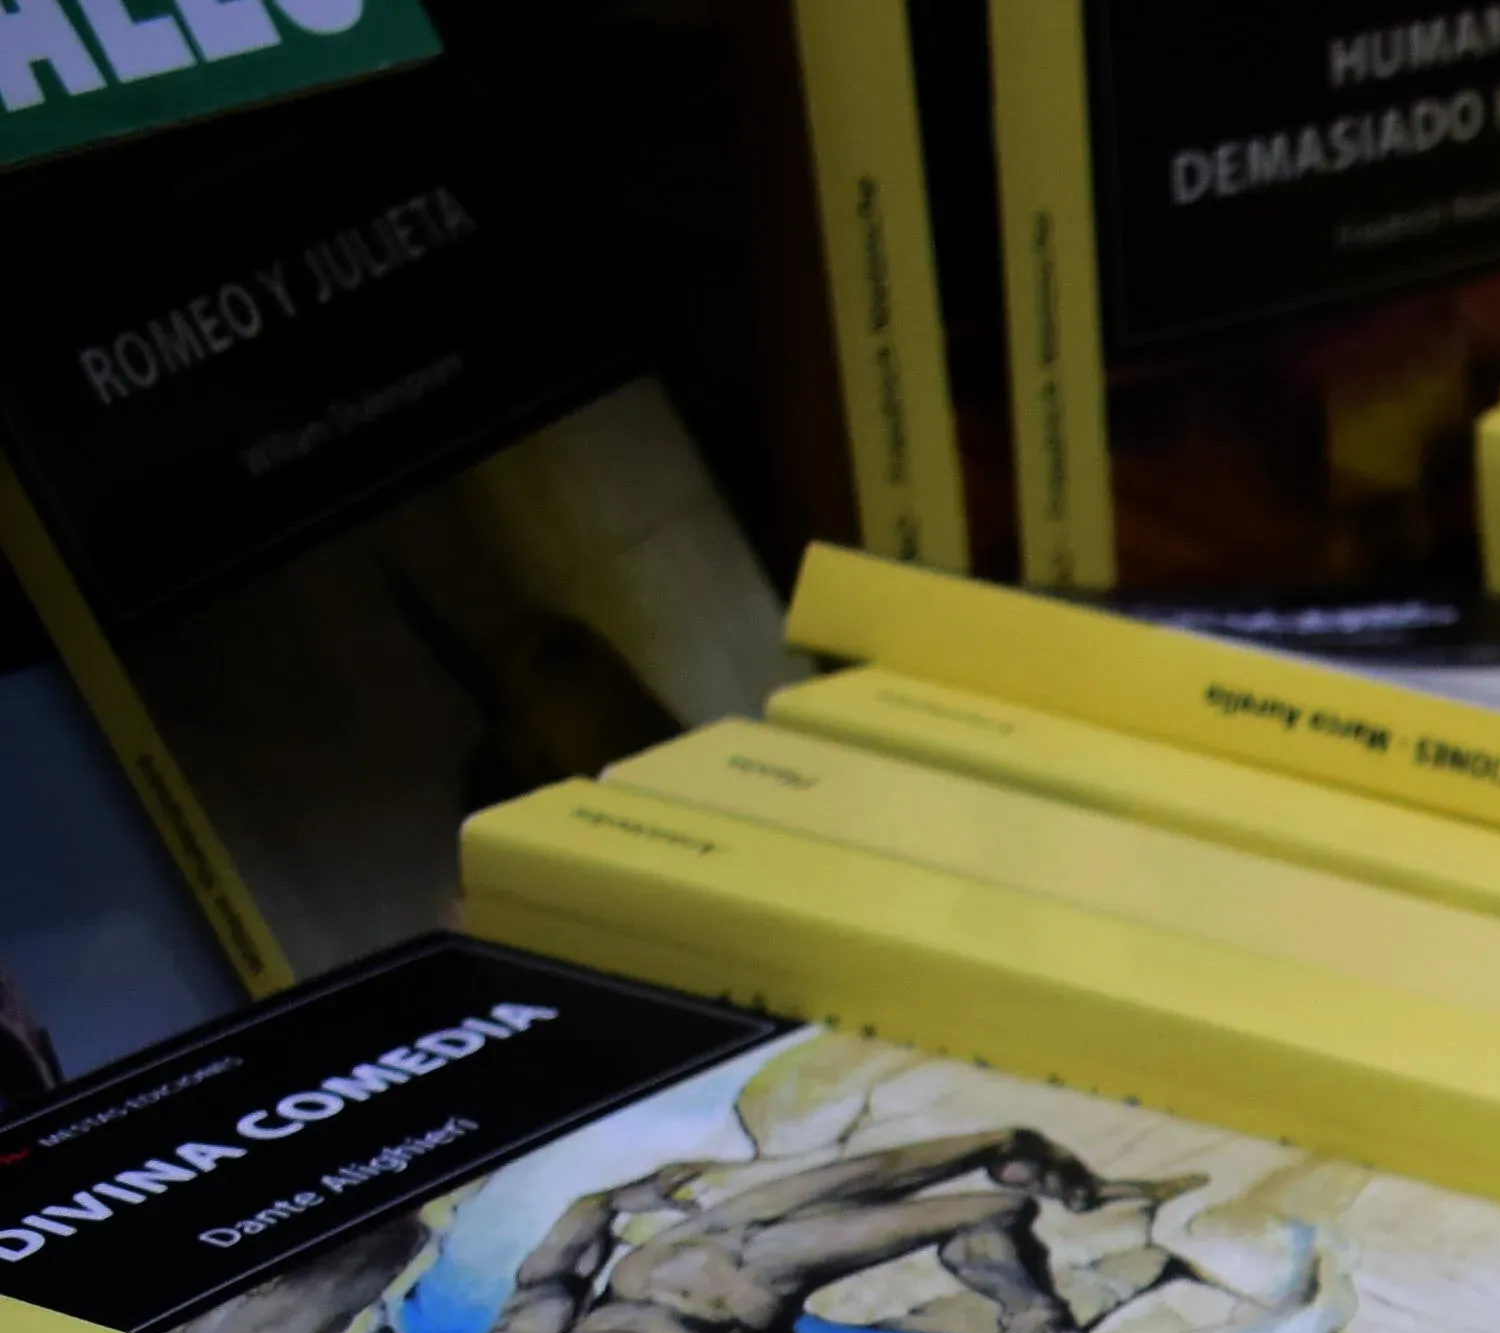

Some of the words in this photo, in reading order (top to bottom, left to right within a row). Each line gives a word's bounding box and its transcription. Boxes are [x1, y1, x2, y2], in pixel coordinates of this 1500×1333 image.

[1172, 90, 1484, 204] DEMASIADO
[79, 284, 262, 405] ROMEO
[259, 264, 295, 316] Y
[305, 186, 473, 303] JULIETA
[1204, 684, 1301, 729] Aurelio
[1308, 711, 1391, 752] Marco
[1, 1142, 247, 1262] DIVINA
[235, 1003, 557, 1139] COMEDIA
[197, 1191, 324, 1248] Dante
[320, 1117, 478, 1193] Alighieri
